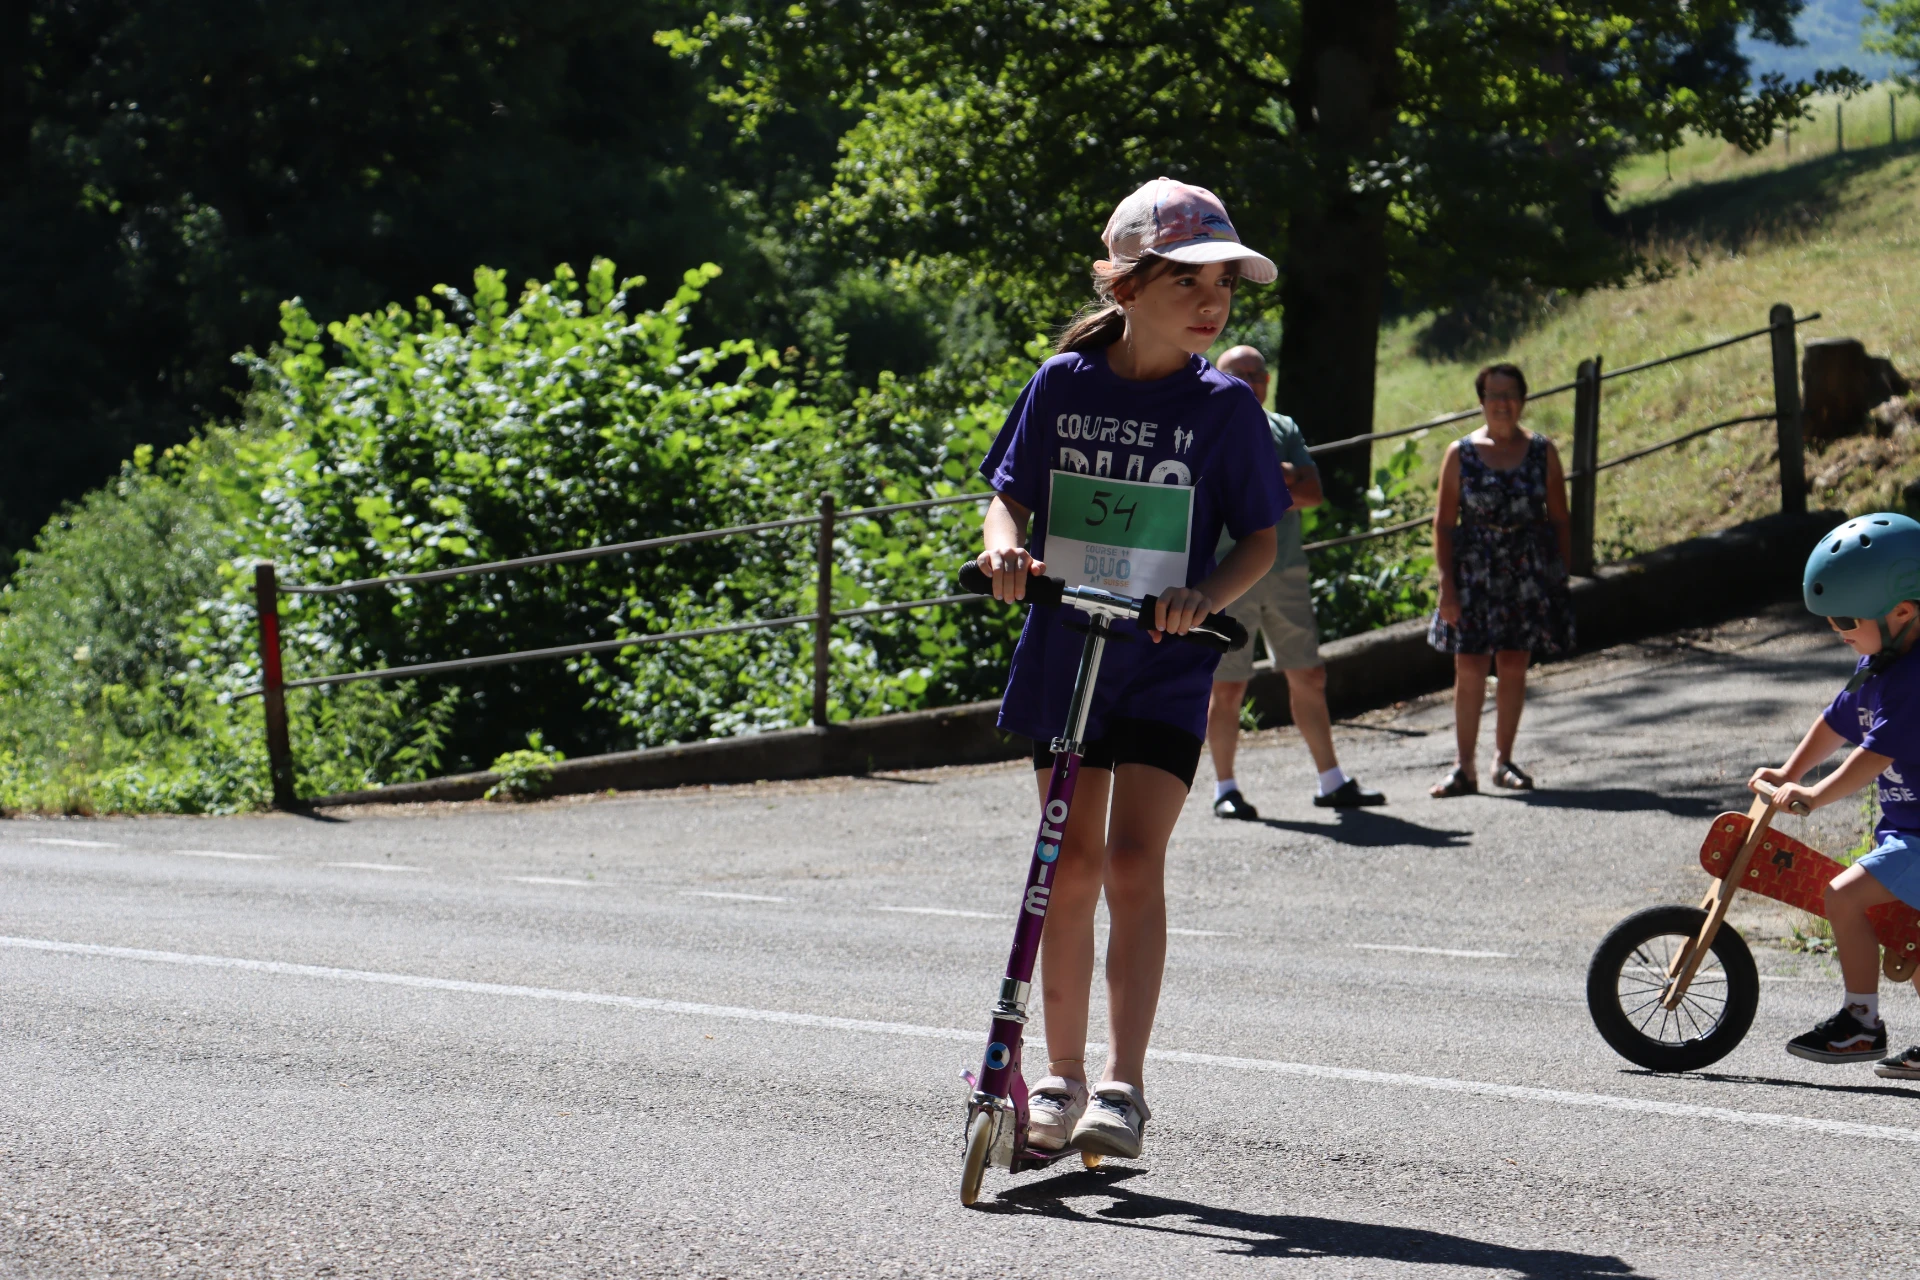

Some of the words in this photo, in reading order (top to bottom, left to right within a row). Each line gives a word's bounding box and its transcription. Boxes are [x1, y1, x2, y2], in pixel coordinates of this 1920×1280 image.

[1056, 413, 1159, 448] COURSE
[1085, 490, 1138, 533] 54
[1085, 544, 1118, 557] COURSE
[1083, 554, 1131, 580] DUO
[1103, 578, 1130, 588] SUISSE
[1024, 799, 1069, 917] micro
